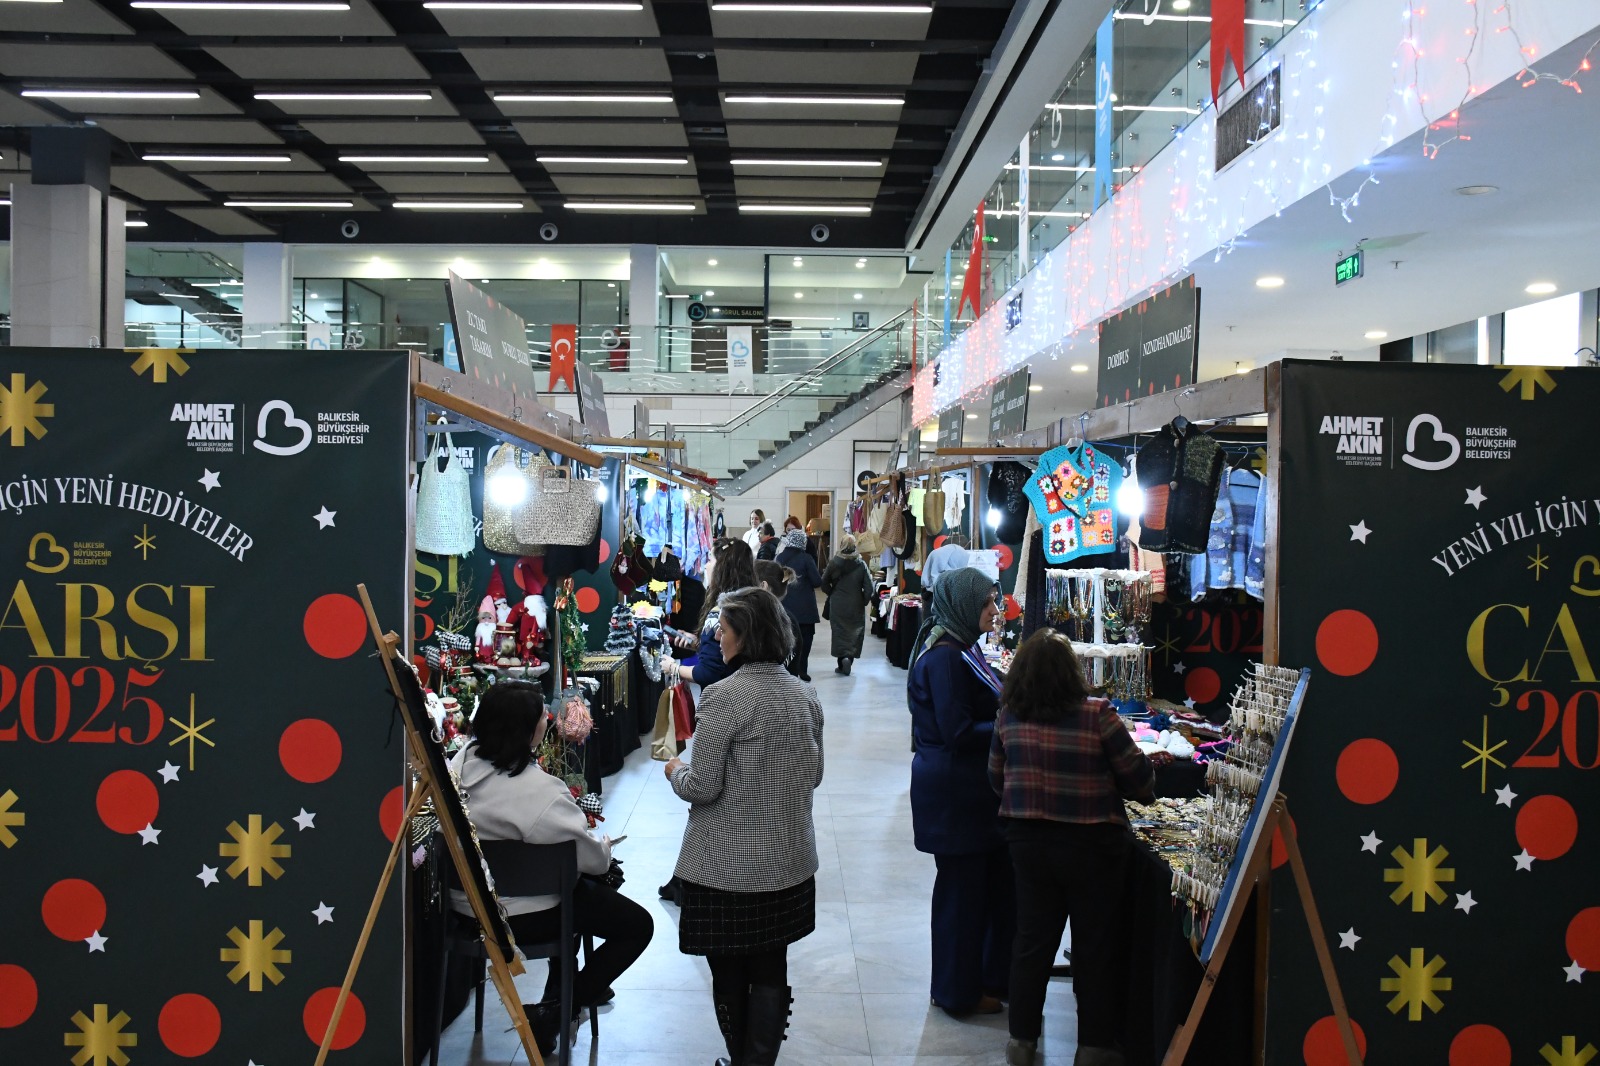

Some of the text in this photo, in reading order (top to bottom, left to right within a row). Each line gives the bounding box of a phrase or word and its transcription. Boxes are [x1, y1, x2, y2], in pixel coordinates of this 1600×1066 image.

[1142, 324, 1192, 357] NZNDHANDMADE
[170, 403, 235, 422] AHMET
[317, 411, 360, 422] BALIKESİR
[186, 421, 234, 441] AKIN
[317, 422, 370, 435] BÜYÜKŞEHİR
[1318, 415, 1384, 436] AHMET
[1465, 425, 1508, 437] BALIKESİR
[317, 433, 364, 445] BELEDİYESİ
[1335, 435, 1383, 455] AKIN
[1465, 437, 1517, 450] BÜYÜKŞEHİR
[1465, 448, 1512, 460] BELEDİYESİ
[54, 473, 114, 506] YENİ
[117, 481, 254, 563] HEDİYELER
[1431, 521, 1493, 577] YENİ
[1490, 512, 1534, 546] YIL
[1534, 495, 1588, 537] İÇİN
